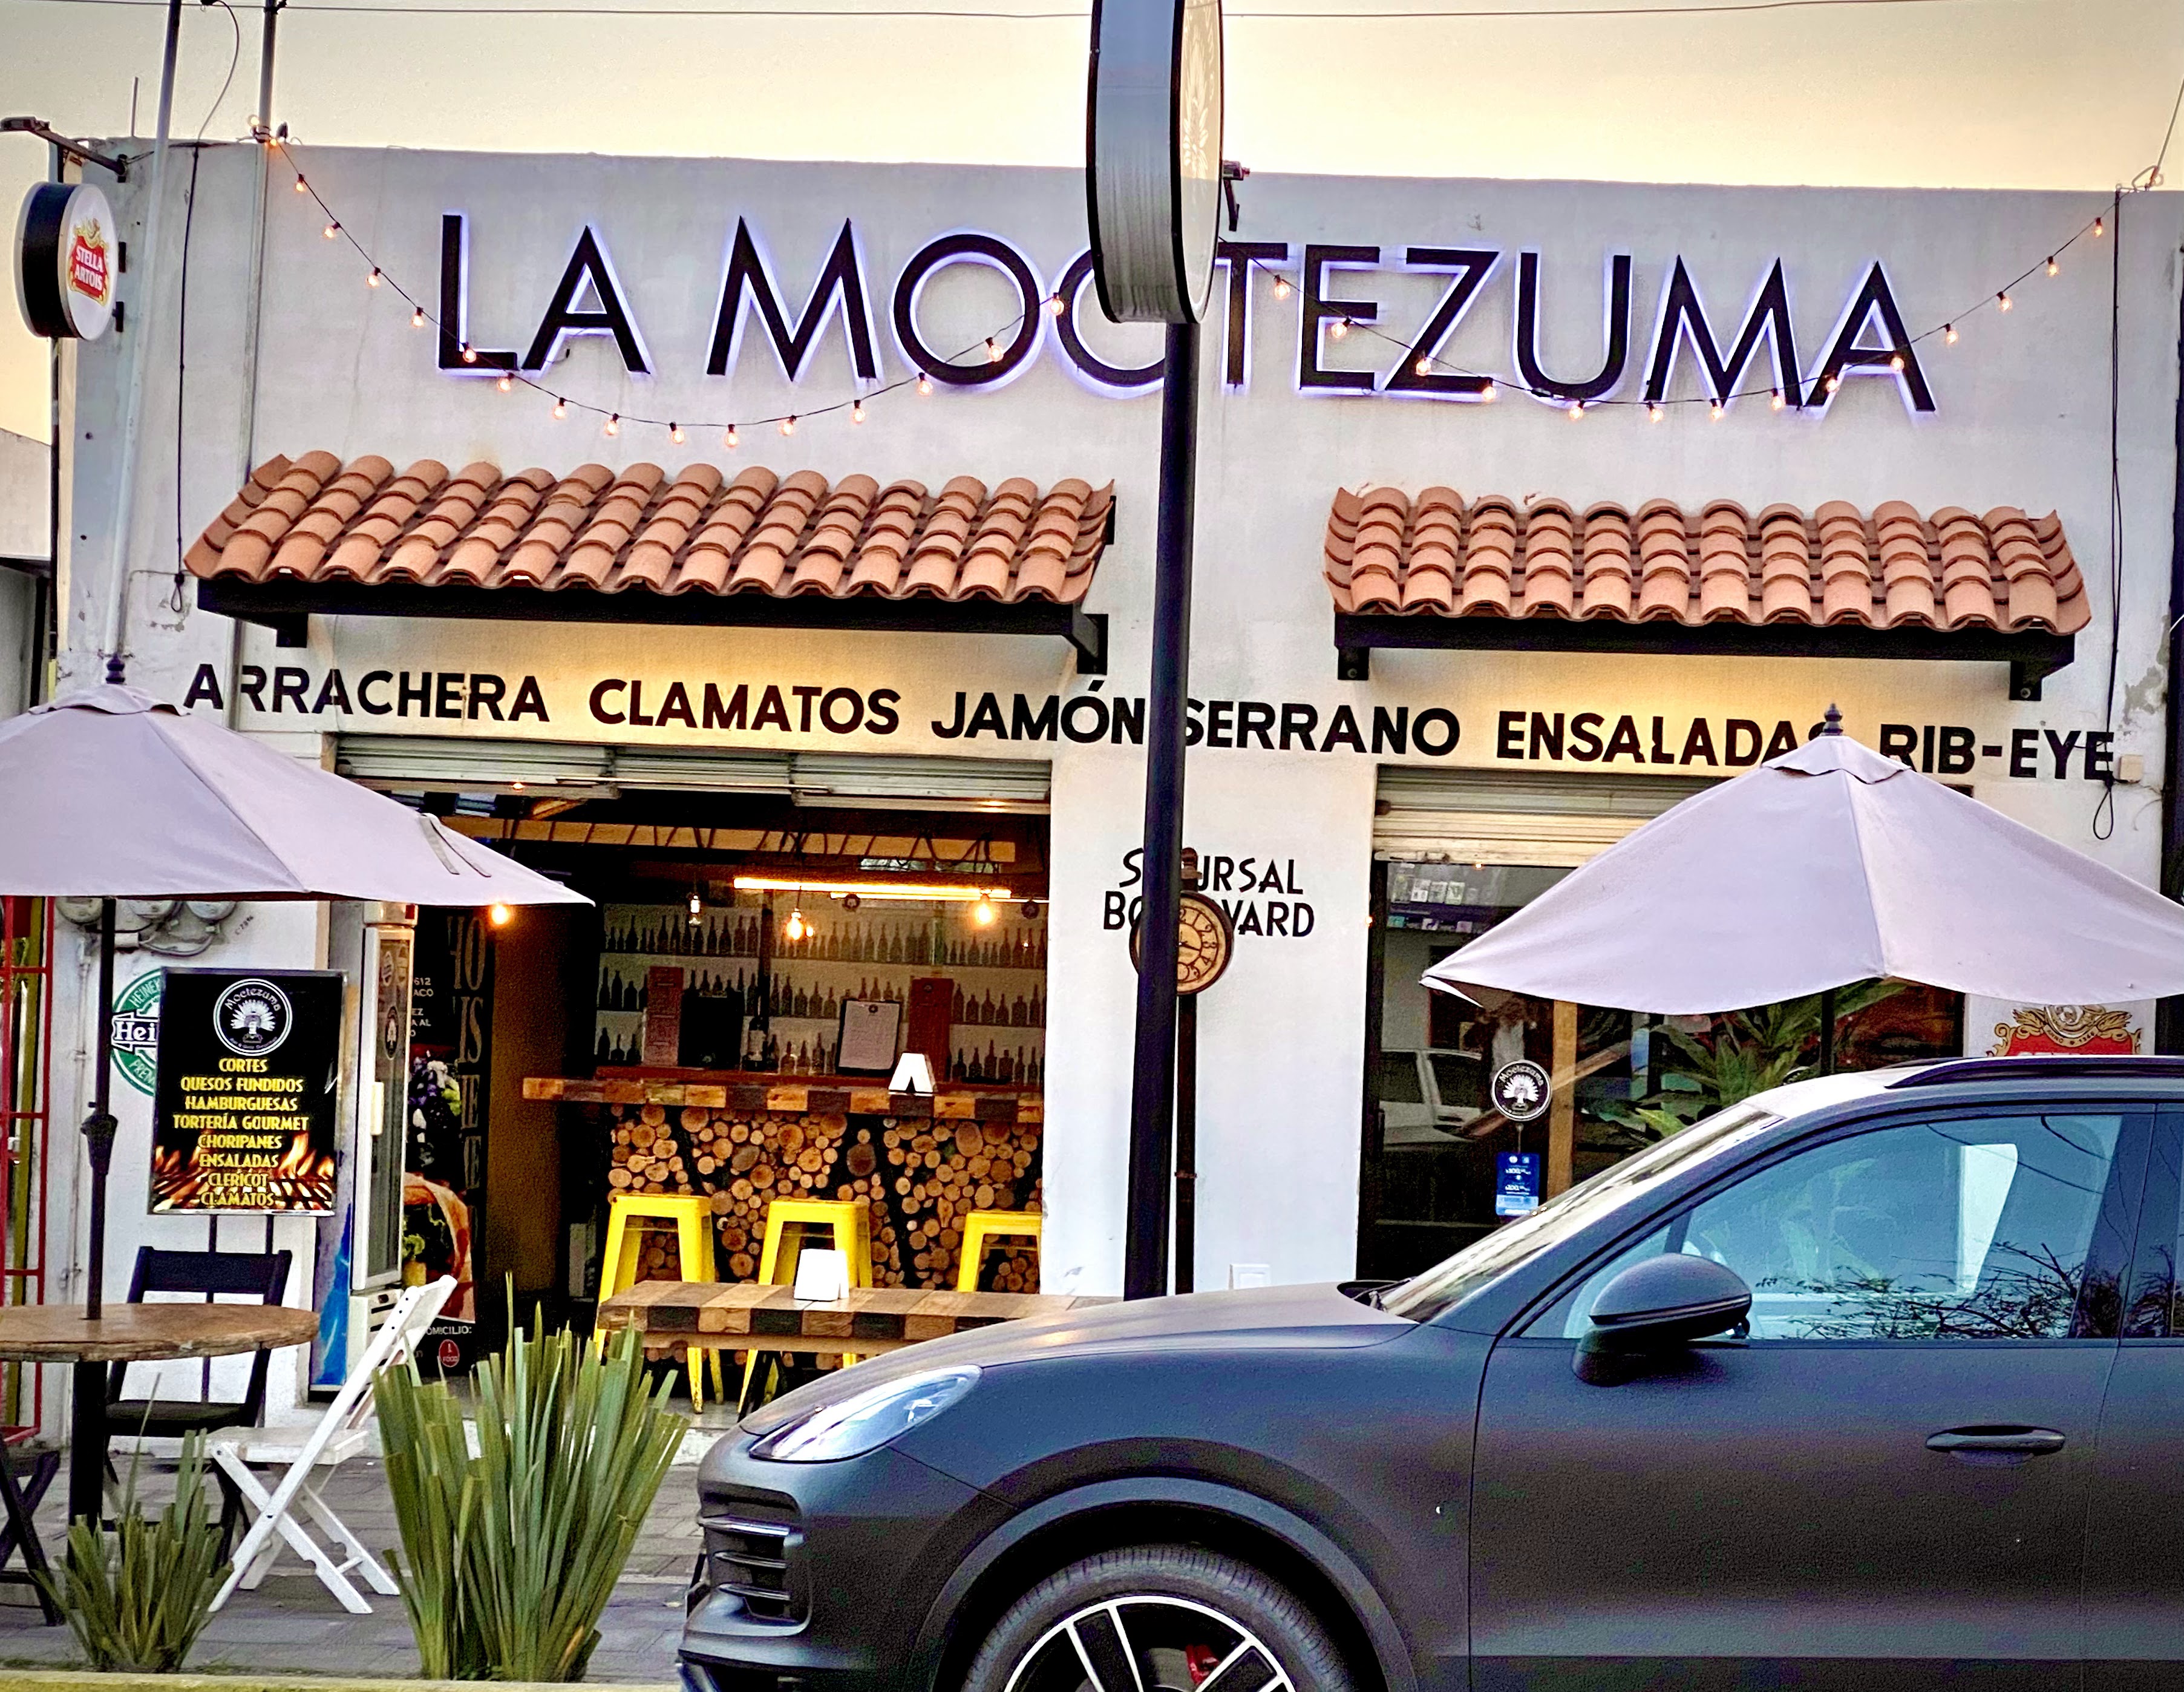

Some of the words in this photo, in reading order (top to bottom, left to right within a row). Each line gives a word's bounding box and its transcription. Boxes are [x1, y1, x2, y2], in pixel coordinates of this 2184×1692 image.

[76, 245, 103, 273] STELLA
[74, 264, 103, 290] ARTOIS
[438, 214, 652, 375] LA
[184, 663, 550, 722] ARRACHERA
[589, 678, 901, 735] CLAMATOS
[931, 680, 1146, 745] JAMÓN
[1184, 698, 1460, 756] SERRANO
[1879, 724, 2114, 781] RIB-EYE
[218, 1058, 268, 1073] CORTES
[180, 1076, 232, 1092] QUESOS
[236, 1077, 304, 1092] FUNDIDOS
[185, 1095, 298, 1111] HAMBURGUESAS
[173, 1113, 238, 1129] TORTERÍA
[241, 1115, 309, 1130] GOURMET
[198, 1134, 283, 1149] CHORIPANES
[199, 1153, 279, 1168] ENSALADAS
[208, 1173, 269, 1187] CLERICOT
[200, 1192, 275, 1206] CLAMATOS
